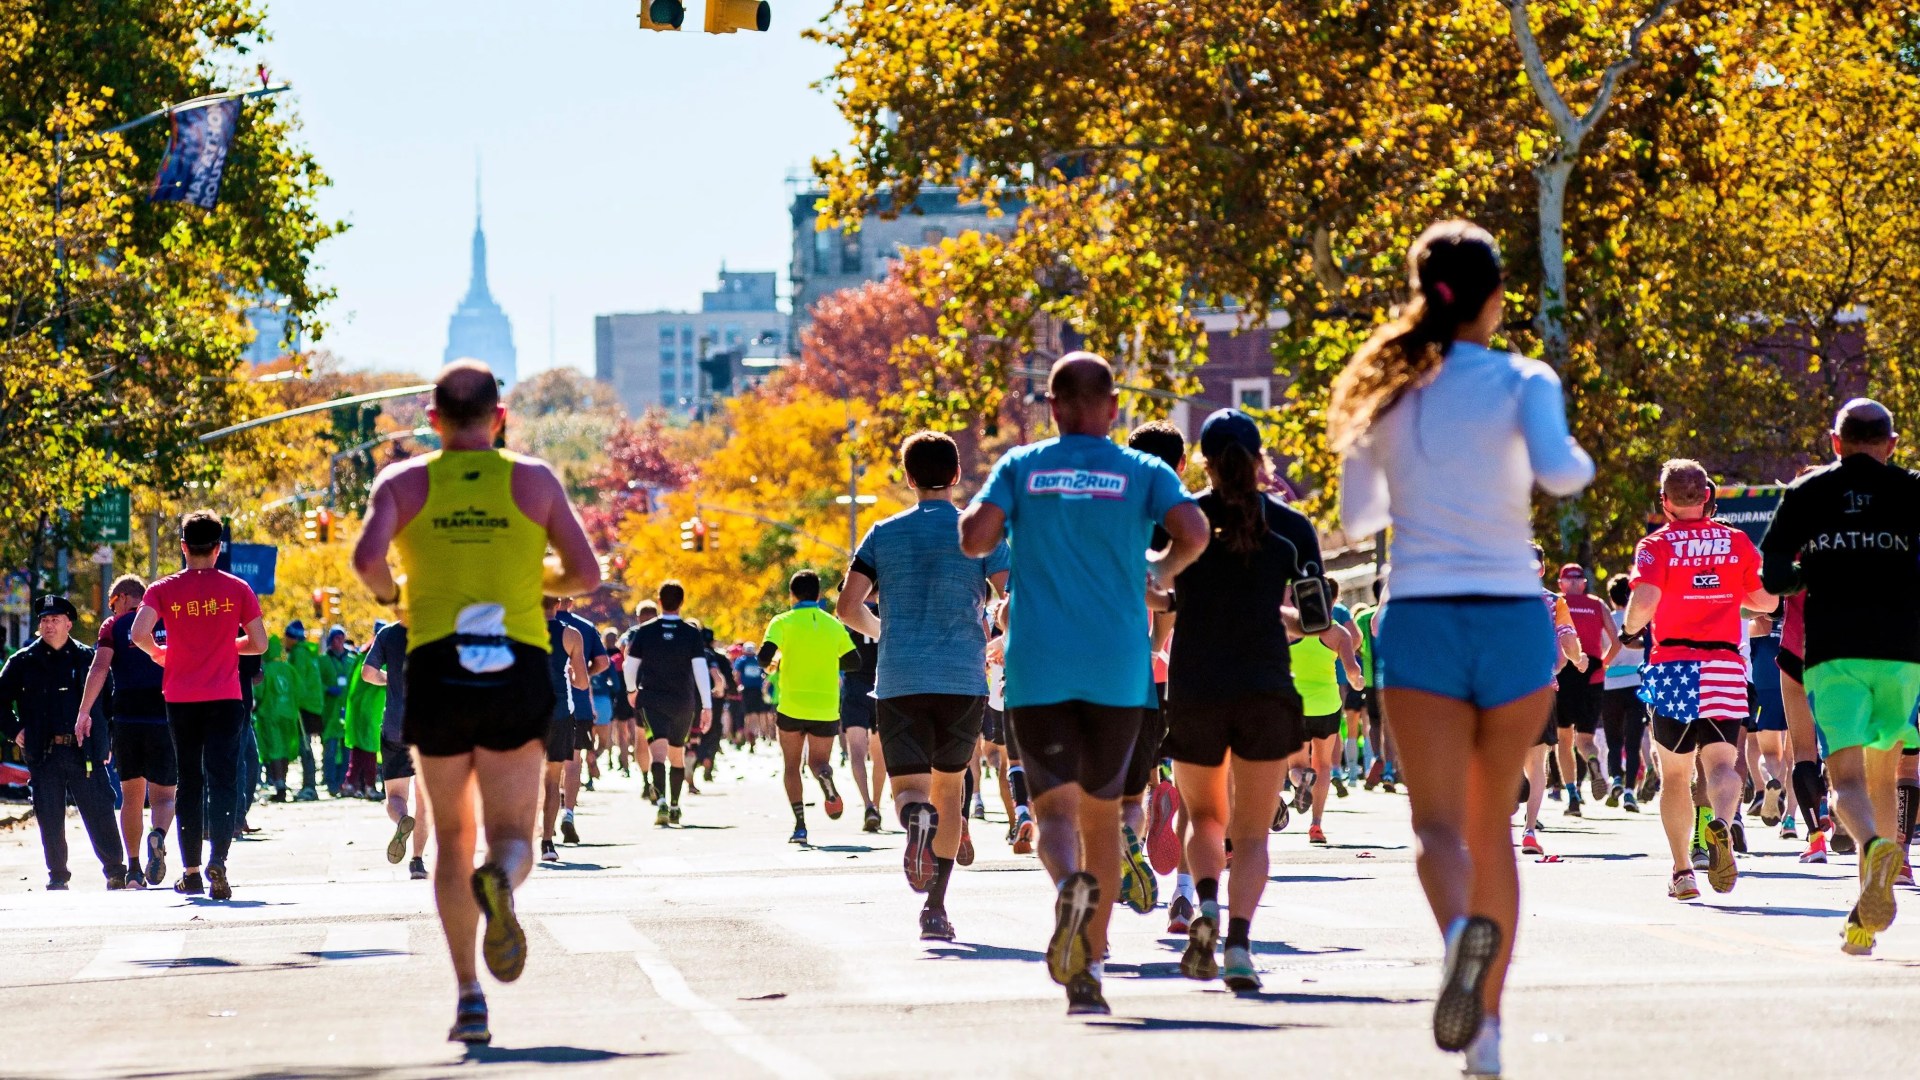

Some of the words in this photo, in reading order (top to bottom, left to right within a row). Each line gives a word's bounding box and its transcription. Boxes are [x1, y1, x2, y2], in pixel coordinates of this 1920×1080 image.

[1033, 472, 1121, 489] Born2Run
[1843, 489, 1873, 514] 1ST
[1716, 510, 1774, 523] ENDURANC
[1665, 527, 1731, 541] DWIGHT
[1671, 538, 1732, 559] TMB
[1669, 555, 1739, 567] RACING
[170, 599, 235, 618] 中国博士
